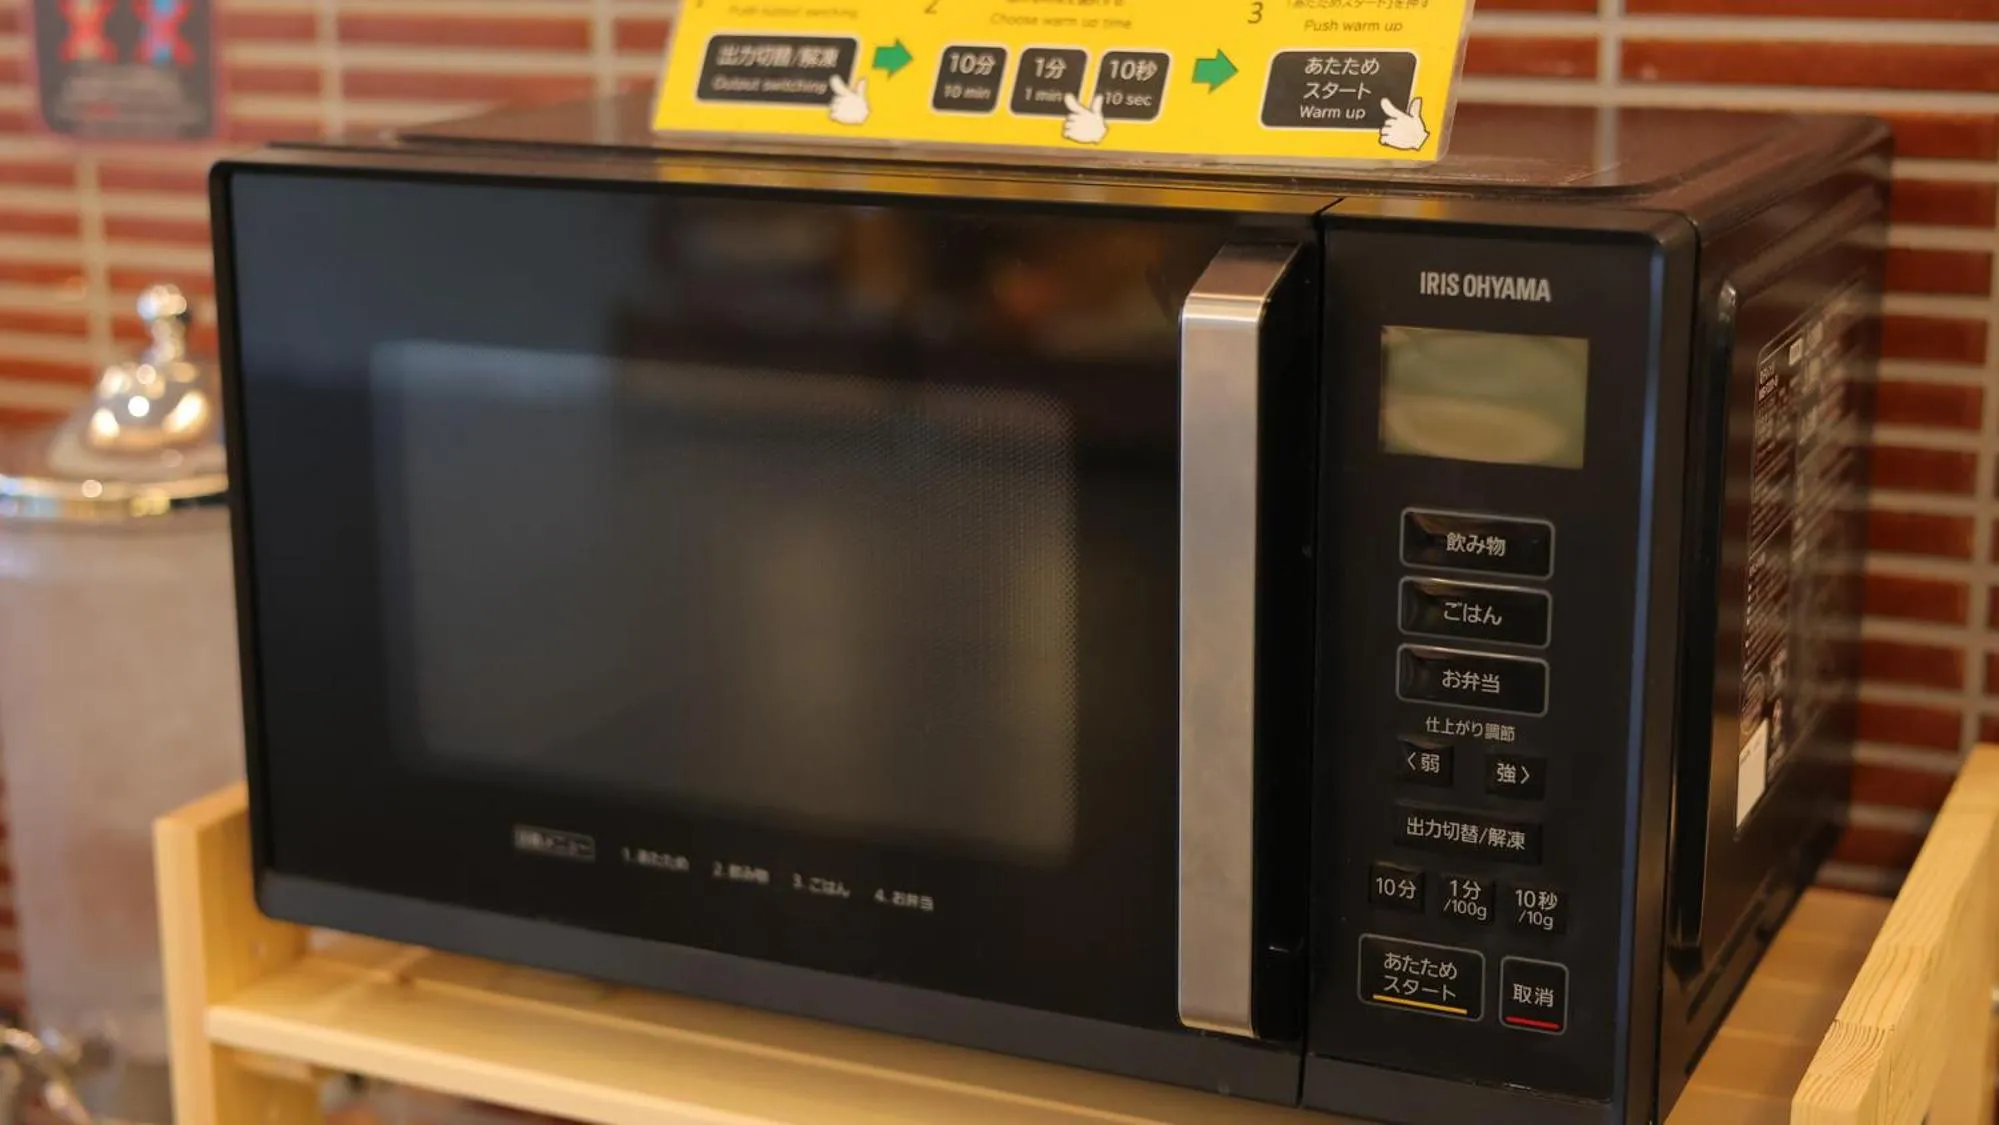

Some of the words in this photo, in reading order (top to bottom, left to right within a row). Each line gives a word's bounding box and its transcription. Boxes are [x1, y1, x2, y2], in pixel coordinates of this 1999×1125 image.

[990, 13, 1038, 26] Choose
[1248, 2, 1263, 24] 3
[1304, 19, 1338, 32] Push
[1343, 21, 1379, 32] warm
[1384, 21, 1403, 34] up
[950, 52, 997, 75] 10分
[1034, 56, 1066, 79] 1分
[1109, 59, 1157, 81] 10秒
[1305, 57, 1380, 75] あたため
[944, 84, 961, 98] 10
[964, 84, 991, 99] min
[1035, 87, 1062, 102] min
[1105, 91, 1123, 105] 10
[1126, 93, 1152, 106] sec
[1303, 81, 1372, 100] スタート
[1300, 105, 1340, 118] Warm
[1346, 107, 1366, 121] up
[1420, 271, 1460, 297] IRIS
[1463, 274, 1552, 302] OHYAMA
[1446, 531, 1507, 557] 飲み物
[1443, 601, 1502, 626] ごはん
[1442, 670, 1500, 694] お弁当
[1425, 716, 1516, 742] 仕上がり調節
[1406, 816, 1526, 850] 出力切替/解凍
[1376, 877, 1417, 900] 10分
[1450, 879, 1481, 900] 1分
[1443, 898, 1487, 921] /100g
[1515, 889, 1558, 912] 10秒
[1518, 910, 1554, 930] /10g
[1383, 951, 1457, 980] あたため
[1383, 974, 1456, 1001] スタート
[1513, 982, 1554, 1008] 取消
